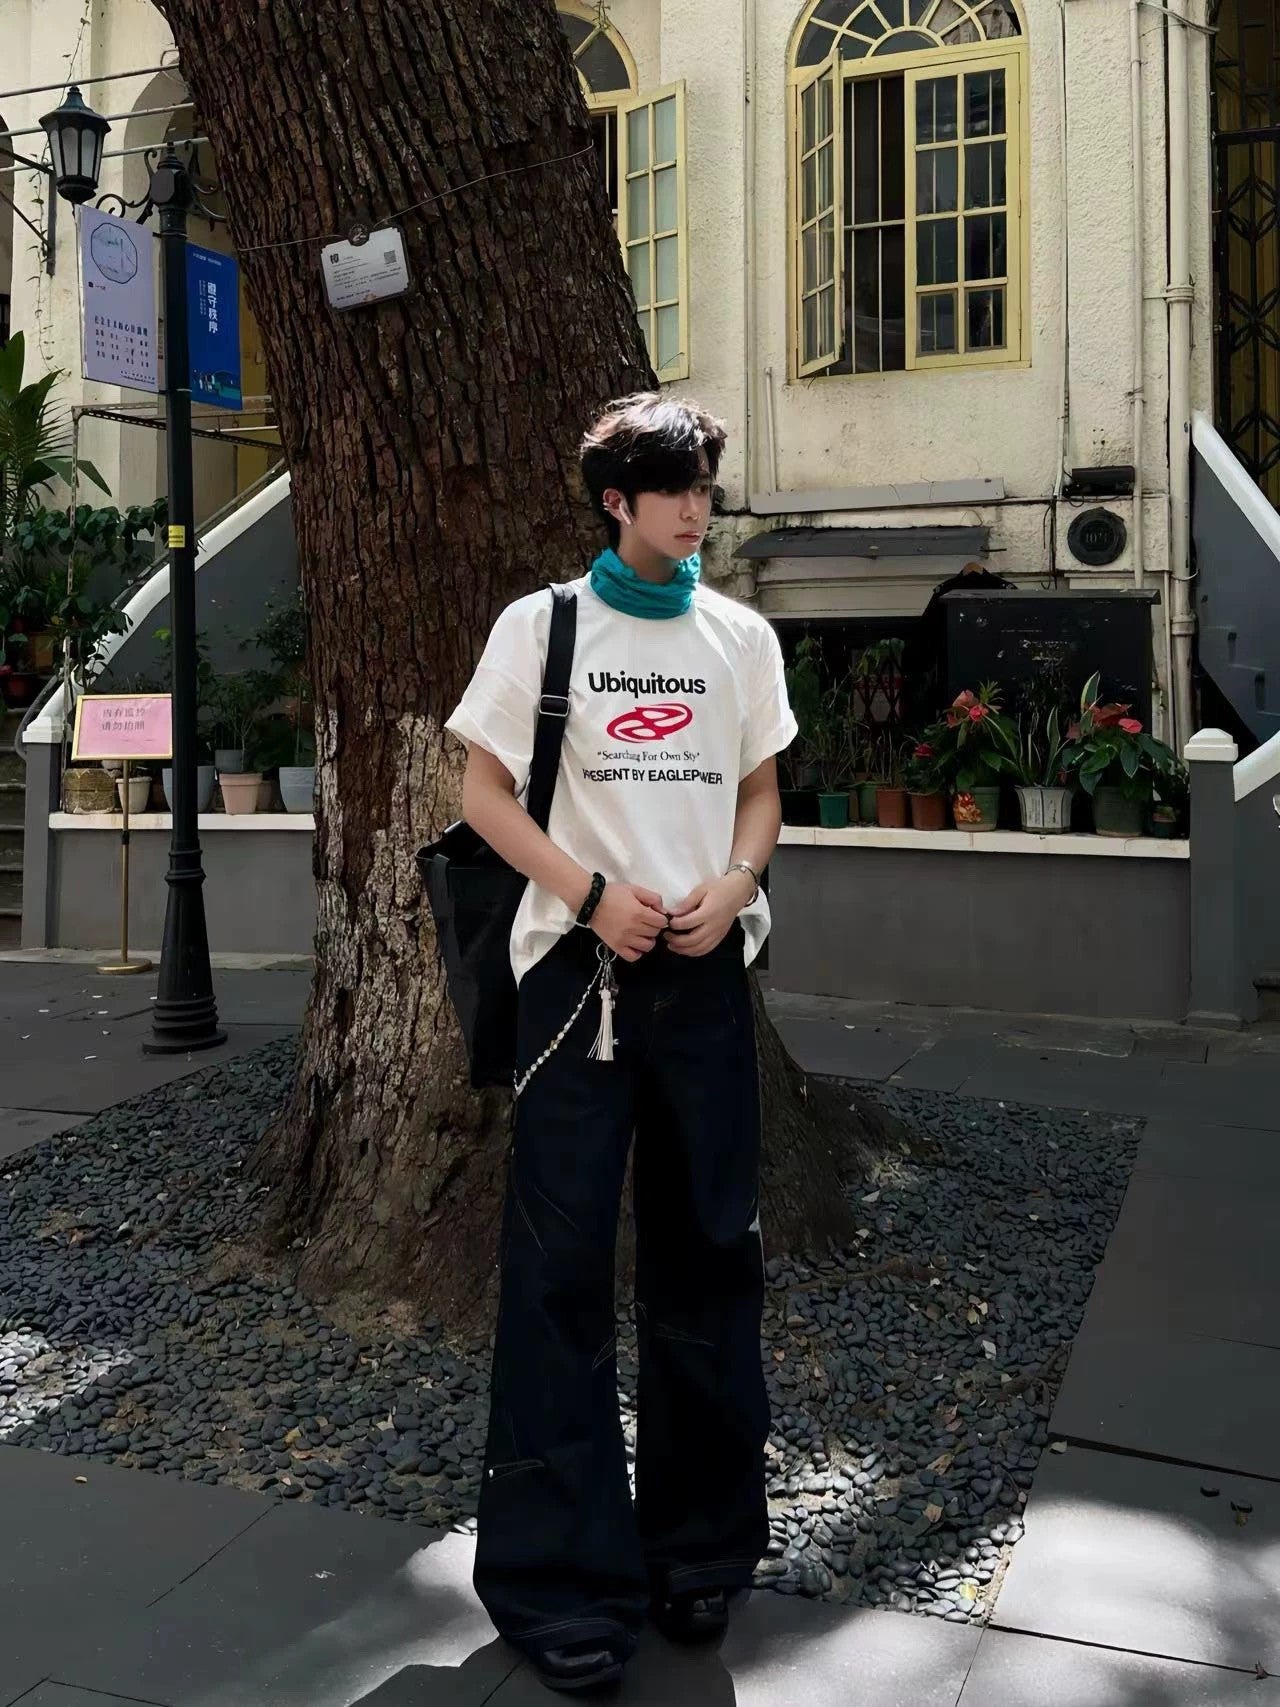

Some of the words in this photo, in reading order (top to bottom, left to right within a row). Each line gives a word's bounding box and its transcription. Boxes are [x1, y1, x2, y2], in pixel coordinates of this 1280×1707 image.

[588, 670, 707, 699] Ubiquitous
[642, 751, 658, 761] For
[660, 751, 681, 761] Own
[632, 769, 645, 781] BY
